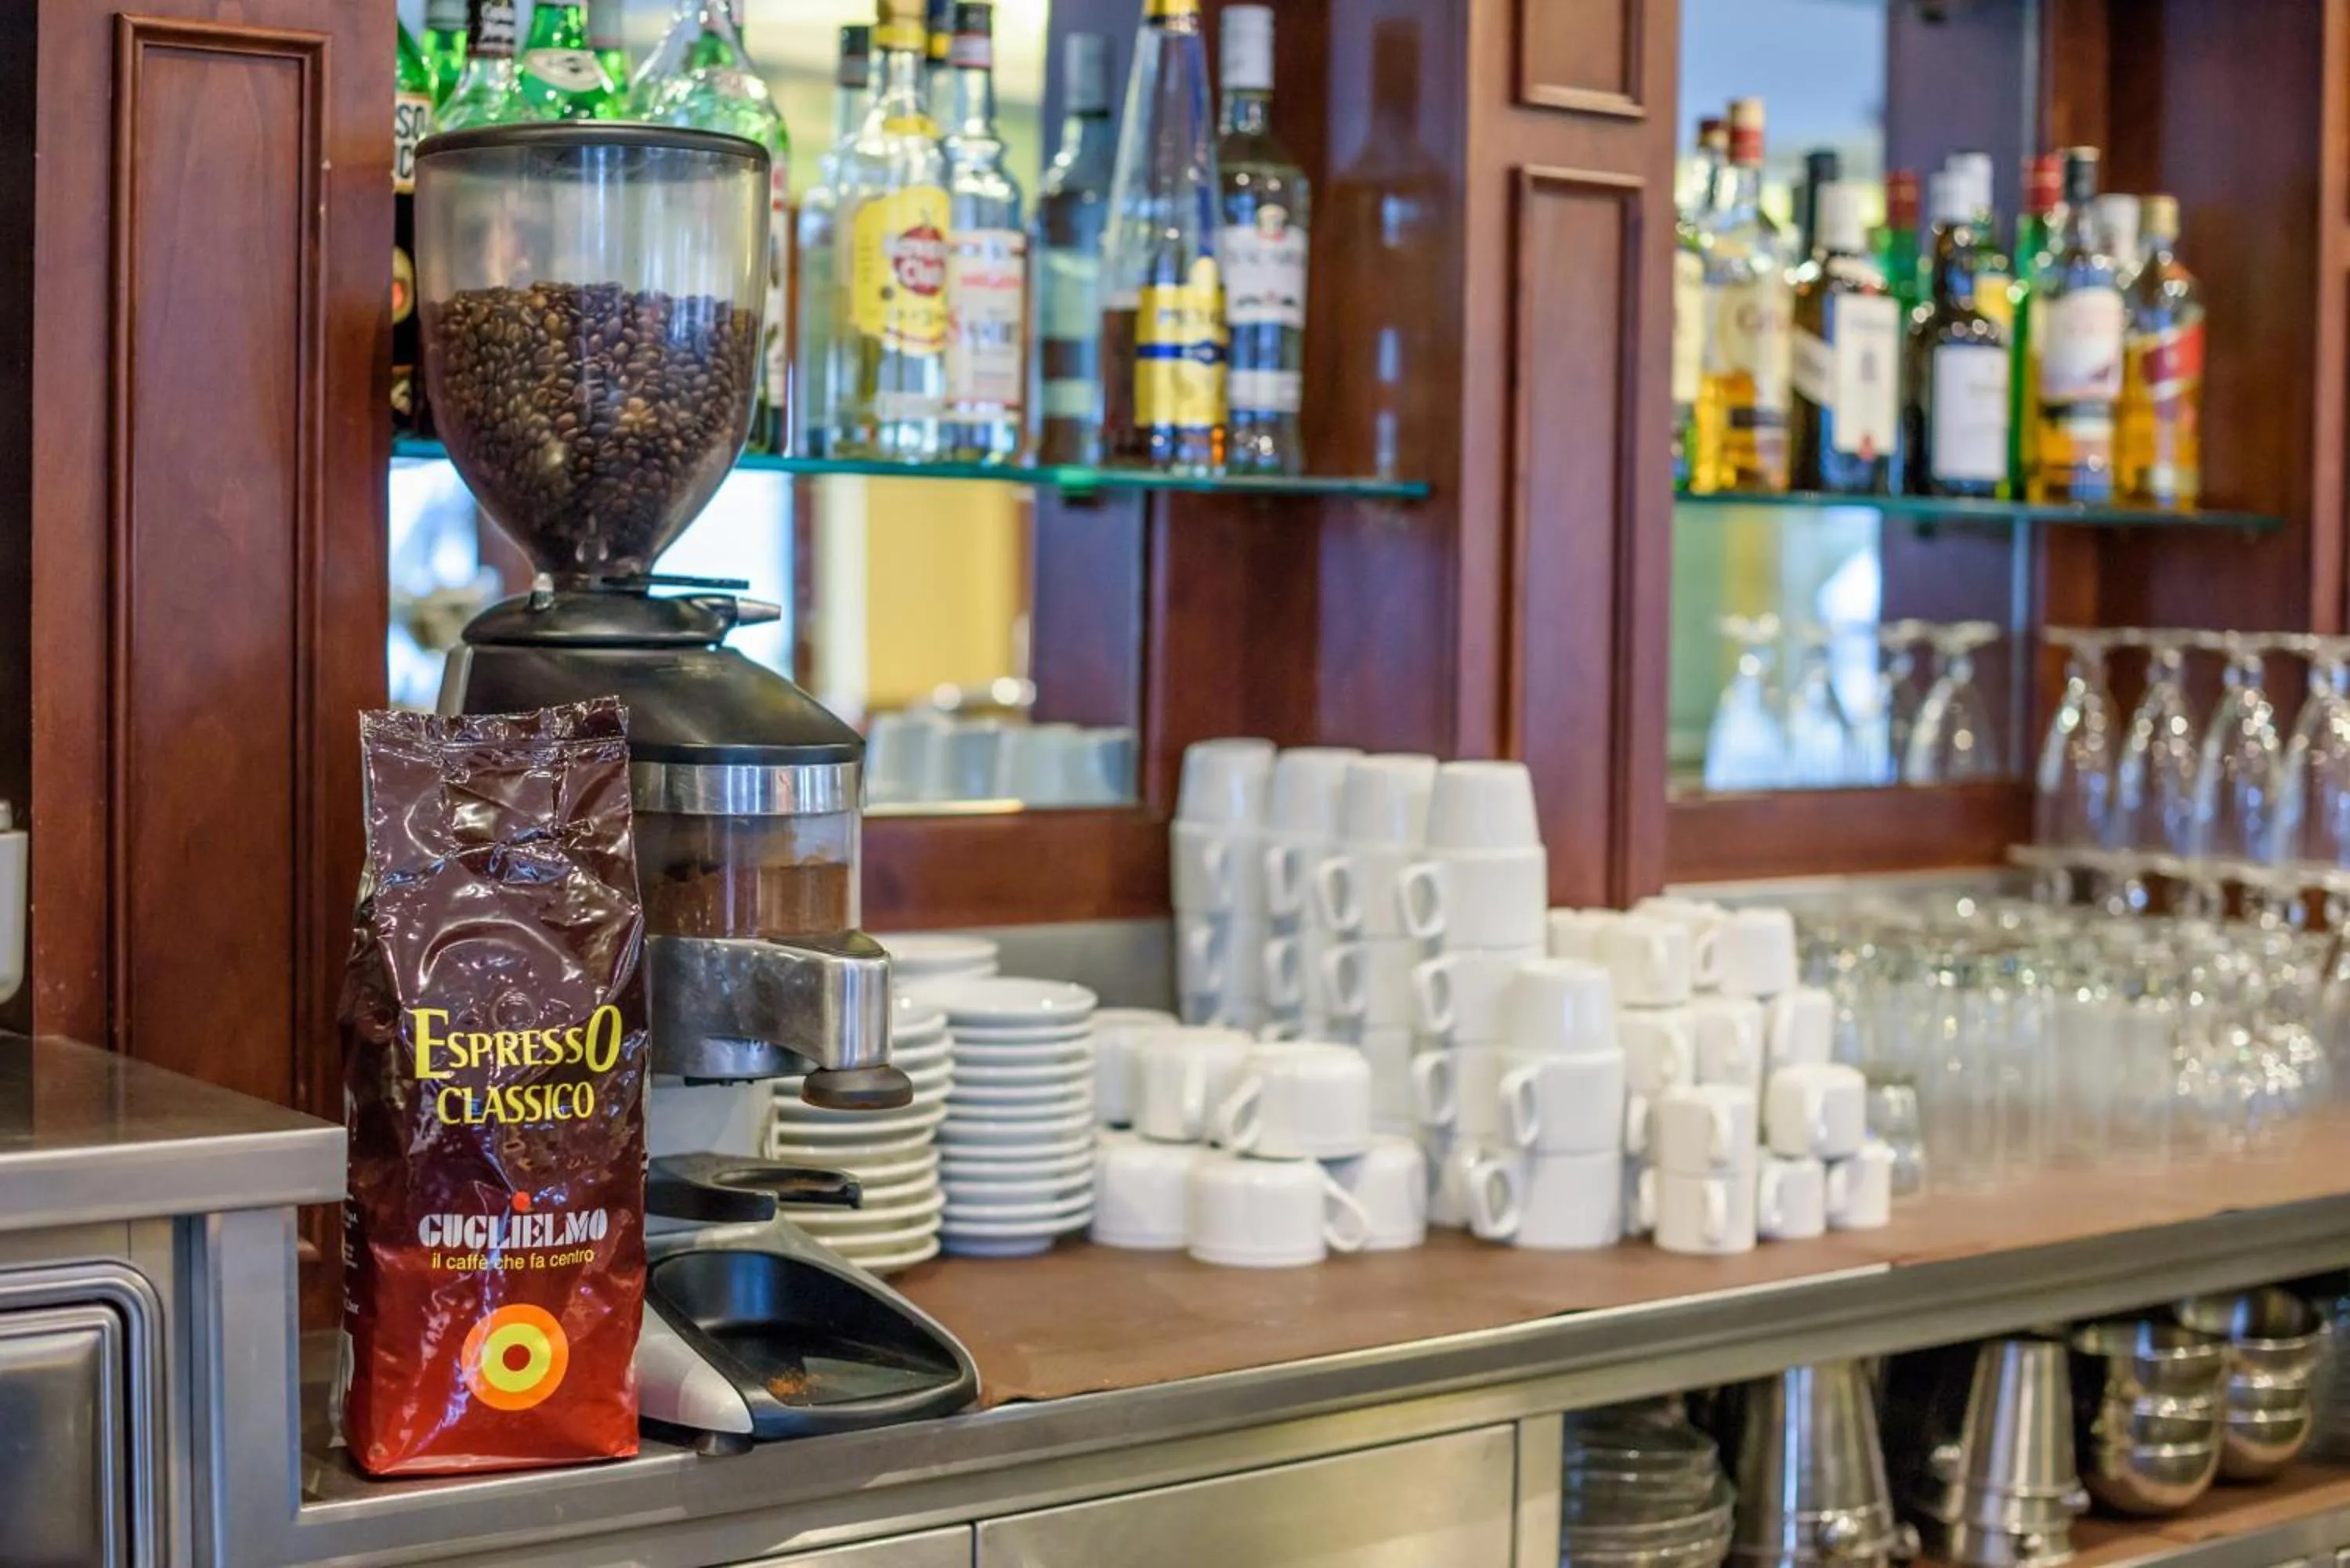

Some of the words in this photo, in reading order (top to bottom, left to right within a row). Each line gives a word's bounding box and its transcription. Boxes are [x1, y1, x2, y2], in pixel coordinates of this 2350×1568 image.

[412, 1005, 623, 1078] ESPRESSO
[437, 1082, 595, 1125] CLASSICO
[418, 1208, 609, 1249] GUGLIELMO
[432, 1253, 441, 1269] il
[446, 1253, 488, 1270] caffè
[494, 1253, 525, 1270] che
[530, 1252, 546, 1269] fa
[550, 1248, 595, 1267] centro
